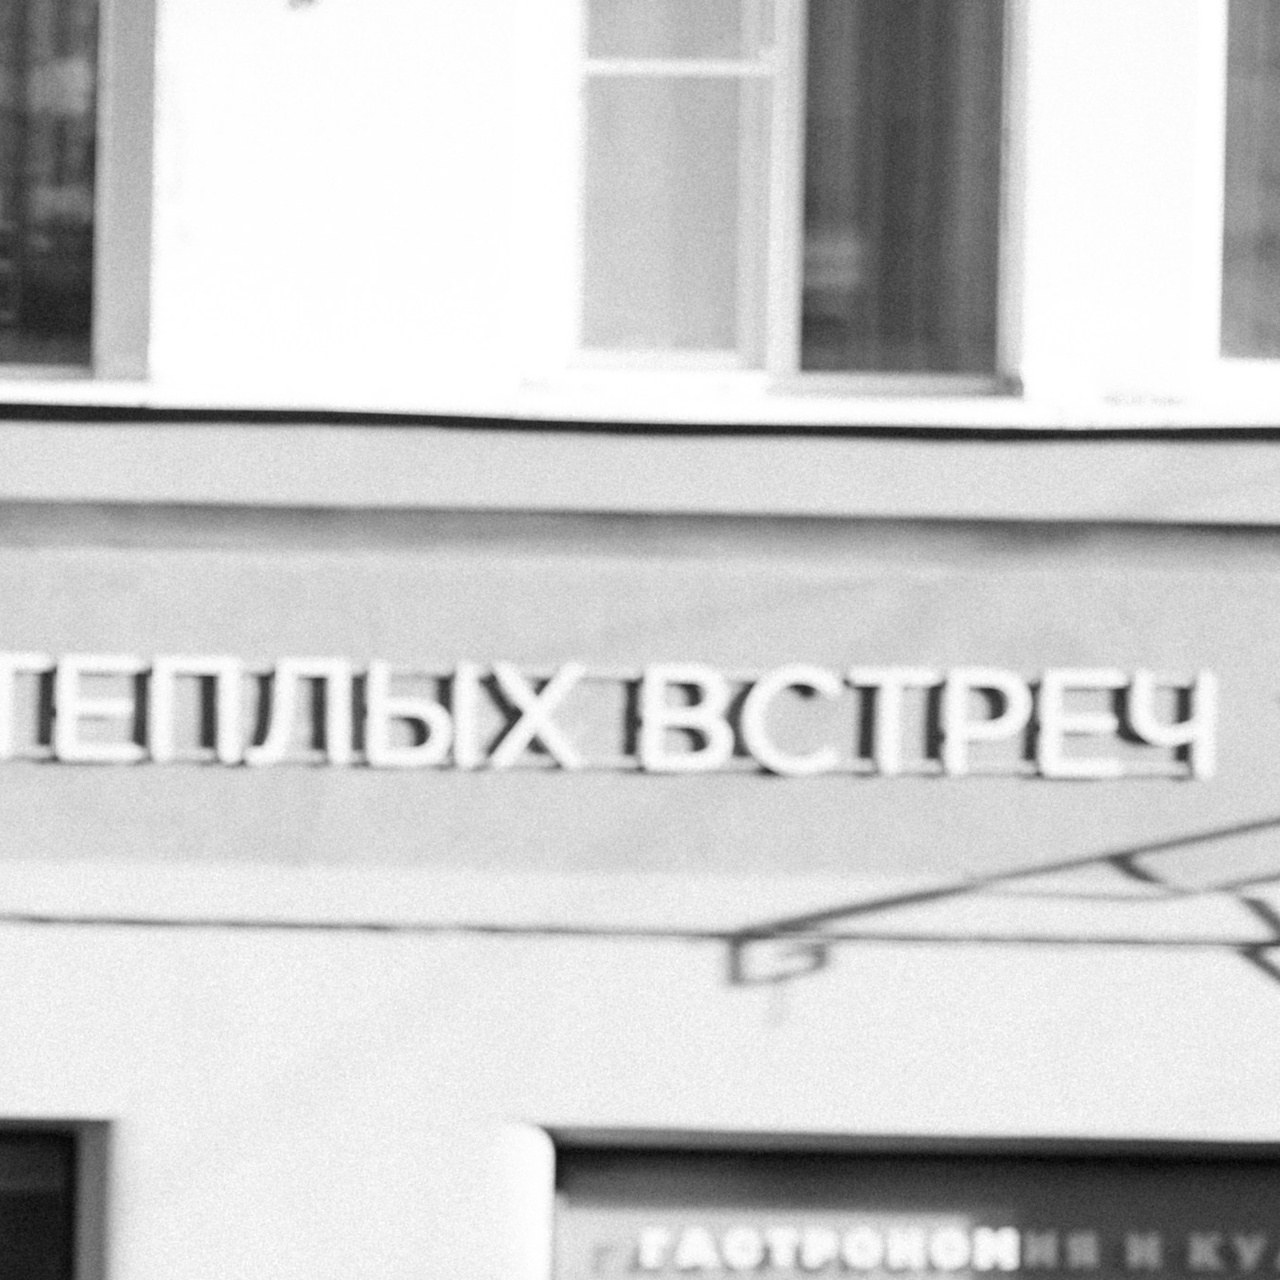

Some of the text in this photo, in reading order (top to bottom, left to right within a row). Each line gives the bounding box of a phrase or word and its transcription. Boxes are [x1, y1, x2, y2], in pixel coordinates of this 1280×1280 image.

[639, 660, 1221, 780] ВСТРЕЧ
[637, 1225, 1280, 1273] ГАСТРОНОМИЯ И КУ
